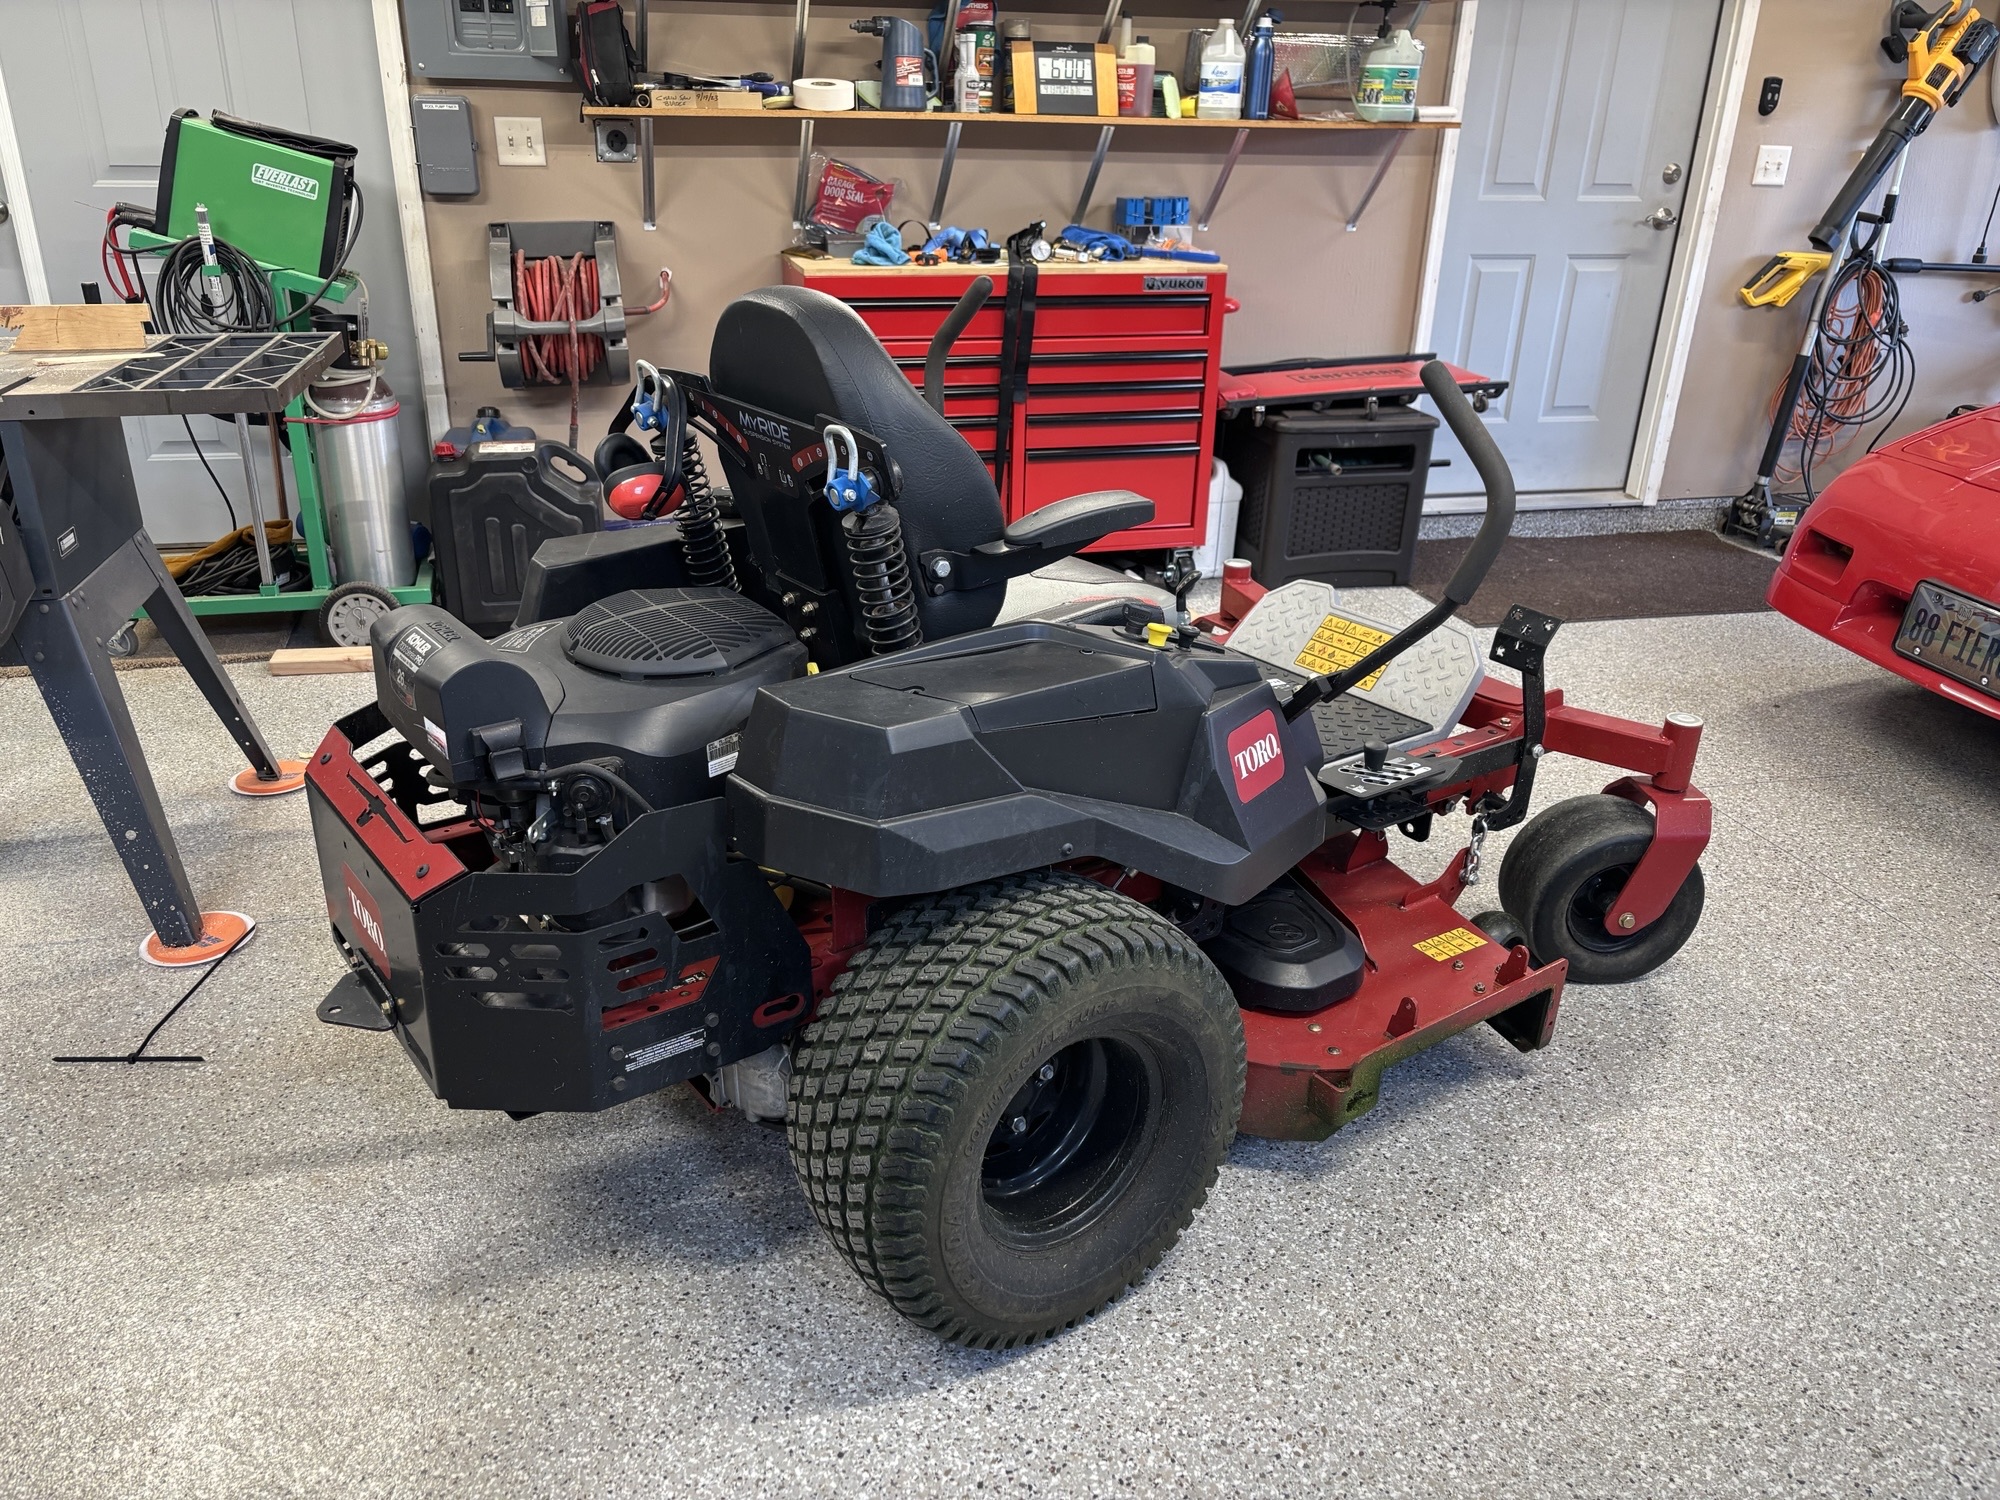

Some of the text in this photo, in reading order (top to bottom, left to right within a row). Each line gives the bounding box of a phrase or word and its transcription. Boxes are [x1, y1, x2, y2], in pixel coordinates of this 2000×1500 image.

[255, 166, 316, 192] EVERLAST
[826, 175, 856, 191] GARAGE
[824, 185, 865, 204] DOOR SEAL
[1160, 279, 1204, 289] YUKON
[405, 632, 432, 656] KOHLER
[1908, 608, 1941, 648] 88
[1939, 620, 2000, 679] FIER
[413, 654, 425, 667] PRO
[396, 668, 405, 686] 26
[1234, 733, 1278, 780] TORO
[347, 886, 385, 952] TORO
